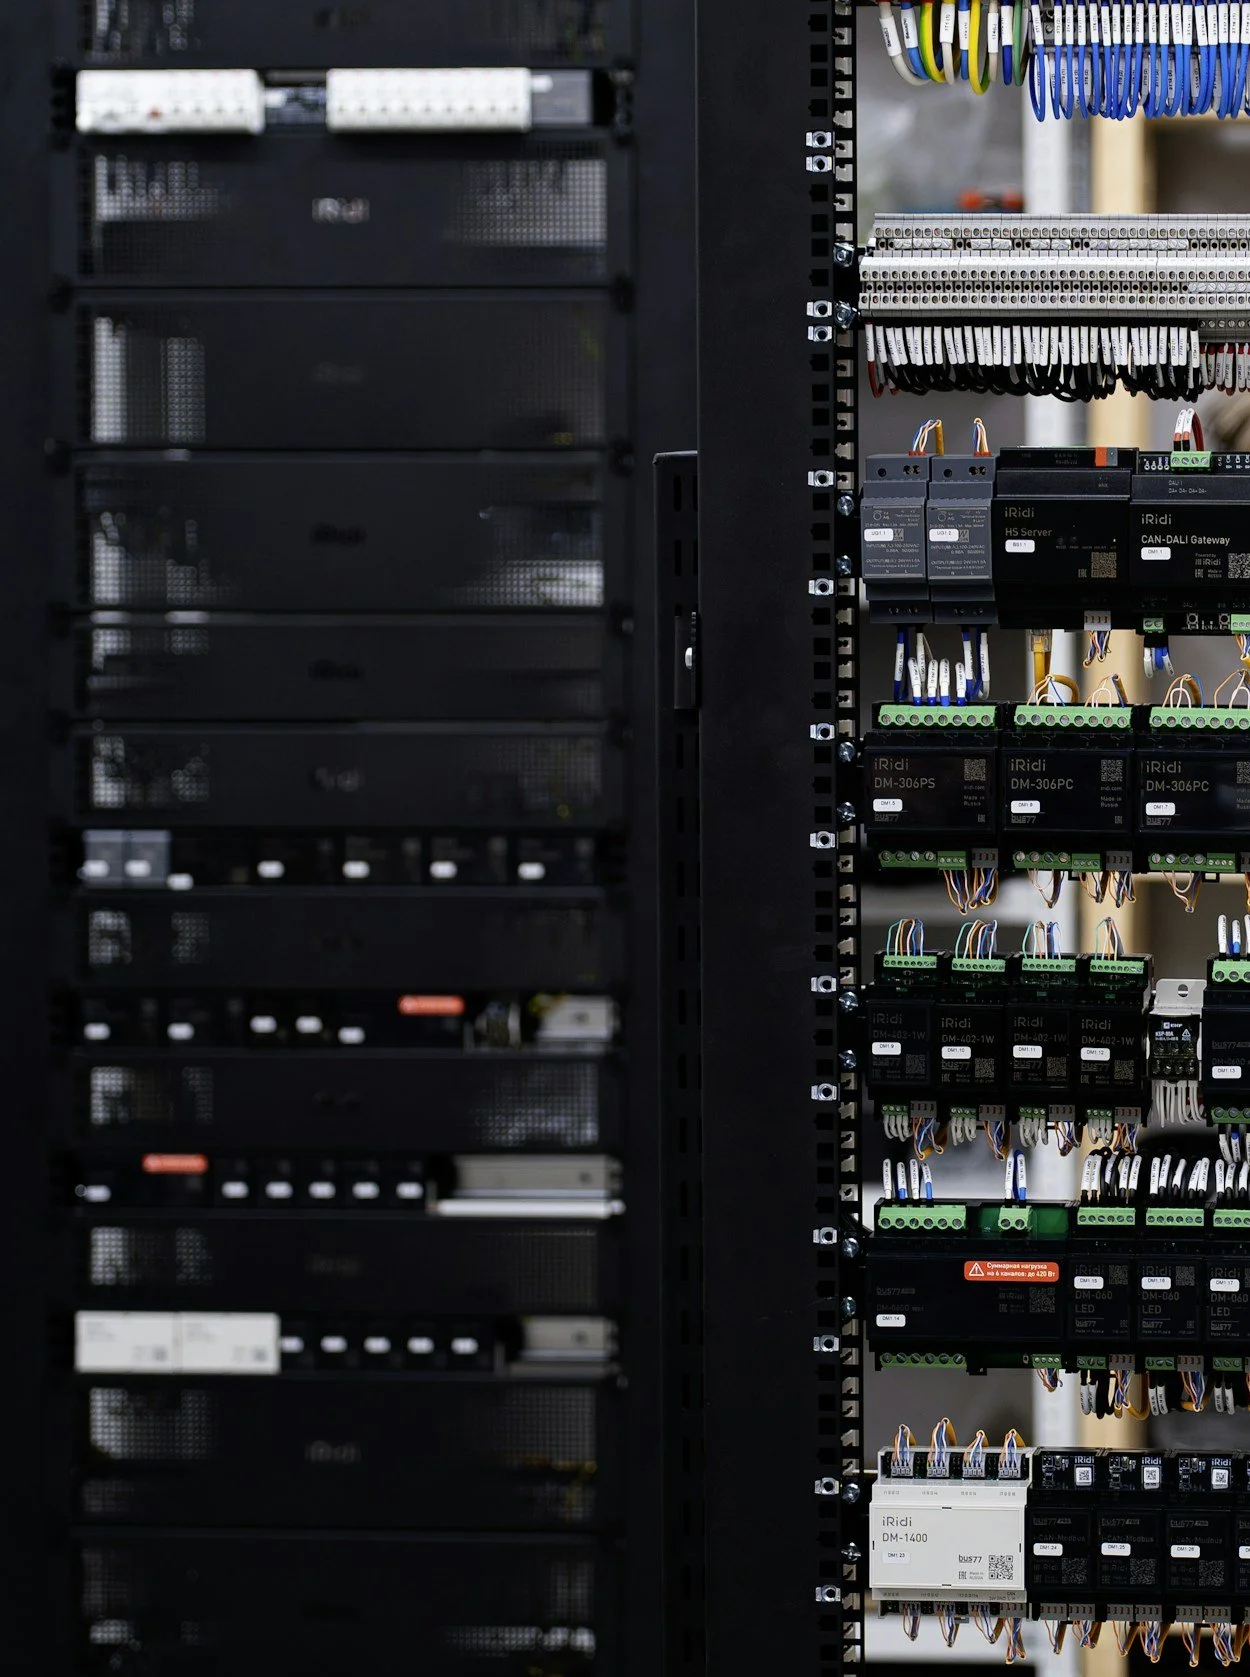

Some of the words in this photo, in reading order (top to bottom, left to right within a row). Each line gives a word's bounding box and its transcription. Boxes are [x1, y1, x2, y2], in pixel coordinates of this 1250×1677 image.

[1004, 506, 1035, 518] iRidi
[1141, 514, 1172, 525] iRidi
[1005, 528, 1018, 537] HS
[1020, 528, 1053, 537] Server
[1141, 535, 1188, 545] CAN-DALI
[1190, 535, 1231, 547] Gateway
[1202, 558, 1221, 566] iRidi
[874, 758, 909, 771] iRidi
[1011, 759, 1046, 772] iRidi
[1146, 761, 1182, 773] iRidi
[874, 778, 936, 789] DM-306PS
[1011, 778, 1074, 790] DM-306PC
[1146, 780, 1210, 792] DM-306PC
[873, 1013, 903, 1025] iRidi
[941, 1018, 971, 1029] iRidi
[1014, 1017, 1044, 1028] iRidi
[1082, 1019, 1112, 1030] iRidi
[1075, 1264, 1105, 1275] iRidi
[1142, 1266, 1172, 1277] iRidi
[1075, 1291, 1113, 1300] DM-060
[1142, 1292, 1180, 1301] DM-060
[1211, 1294, 1249, 1303] DM-060
[1075, 1304, 1095, 1313] LED
[1142, 1305, 1162, 1314] LED
[1211, 1307, 1231, 1317] LED
[1075, 1456, 1095, 1464] iRidi
[1141, 1457, 1162, 1465] iRidi
[1211, 1458, 1232, 1466] iRidi
[882, 1517, 912, 1527] iRidi
[883, 1533, 928, 1543] DM-1400
[959, 1555, 982, 1563] bus77
